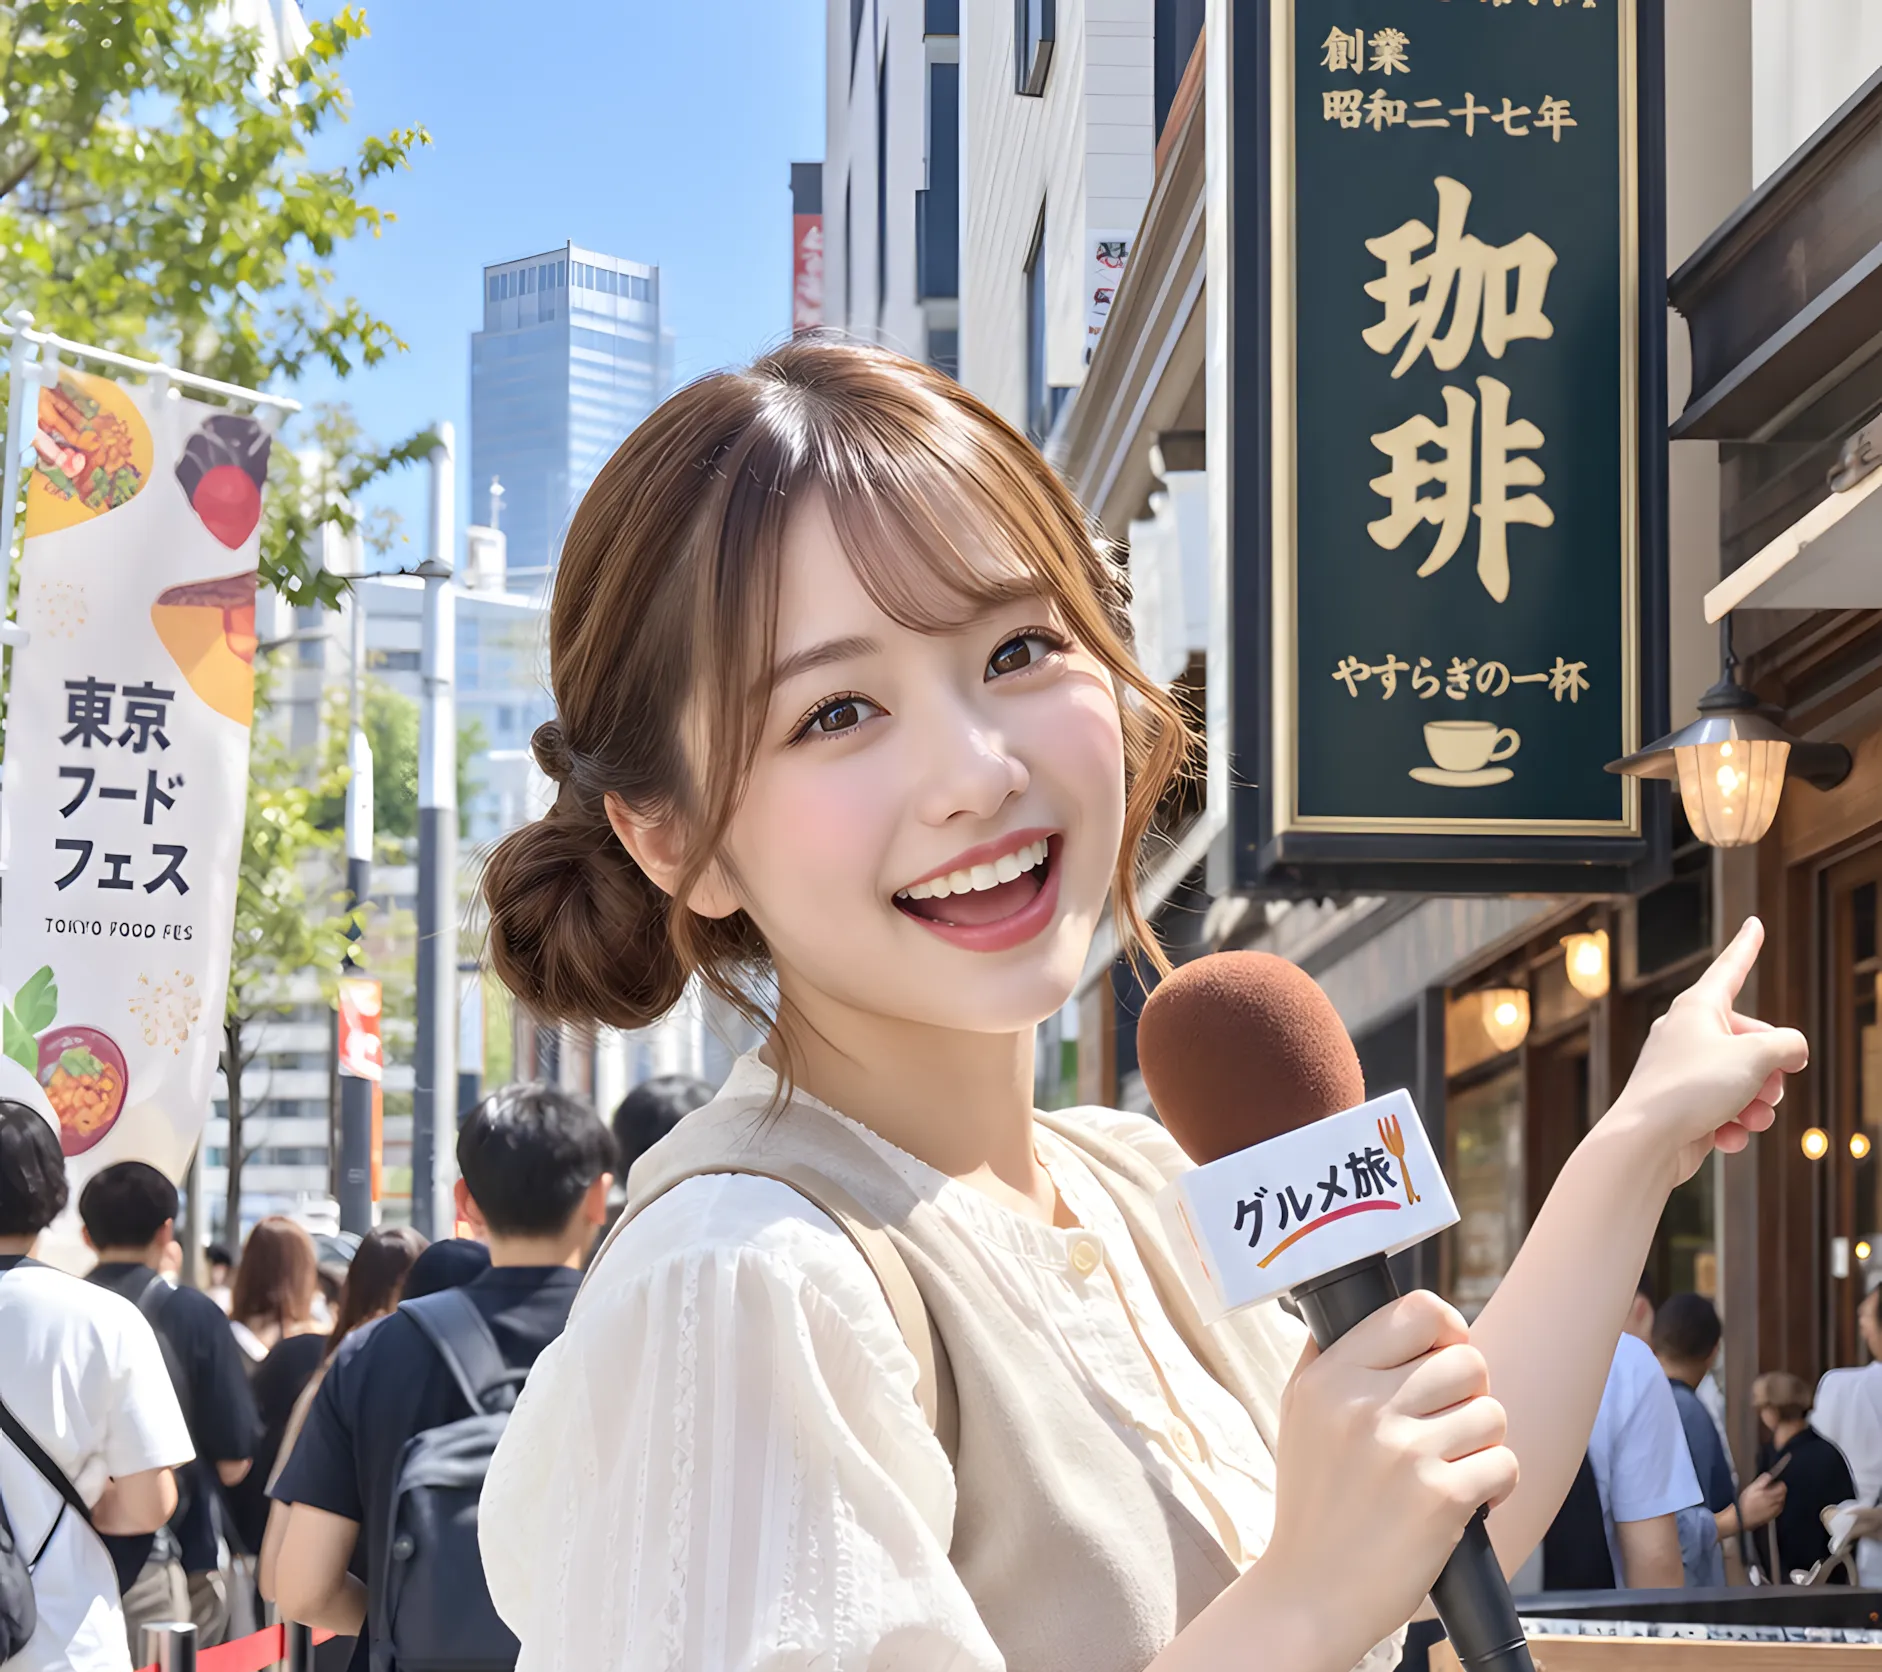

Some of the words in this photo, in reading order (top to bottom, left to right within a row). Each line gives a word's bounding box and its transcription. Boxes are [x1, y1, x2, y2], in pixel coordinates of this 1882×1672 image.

[1320, 26, 1411, 75] 創業
[1322, 88, 1578, 143] 昭和二十七年
[1361, 175, 1558, 604] 珈琲
[1331, 654, 1591, 703] やすらぎの一杯
[59, 675, 176, 754] 東京
[58, 766, 185, 825] フード
[54, 838, 191, 896] フェス
[1233, 1146, 1398, 1248] グルメ旅
